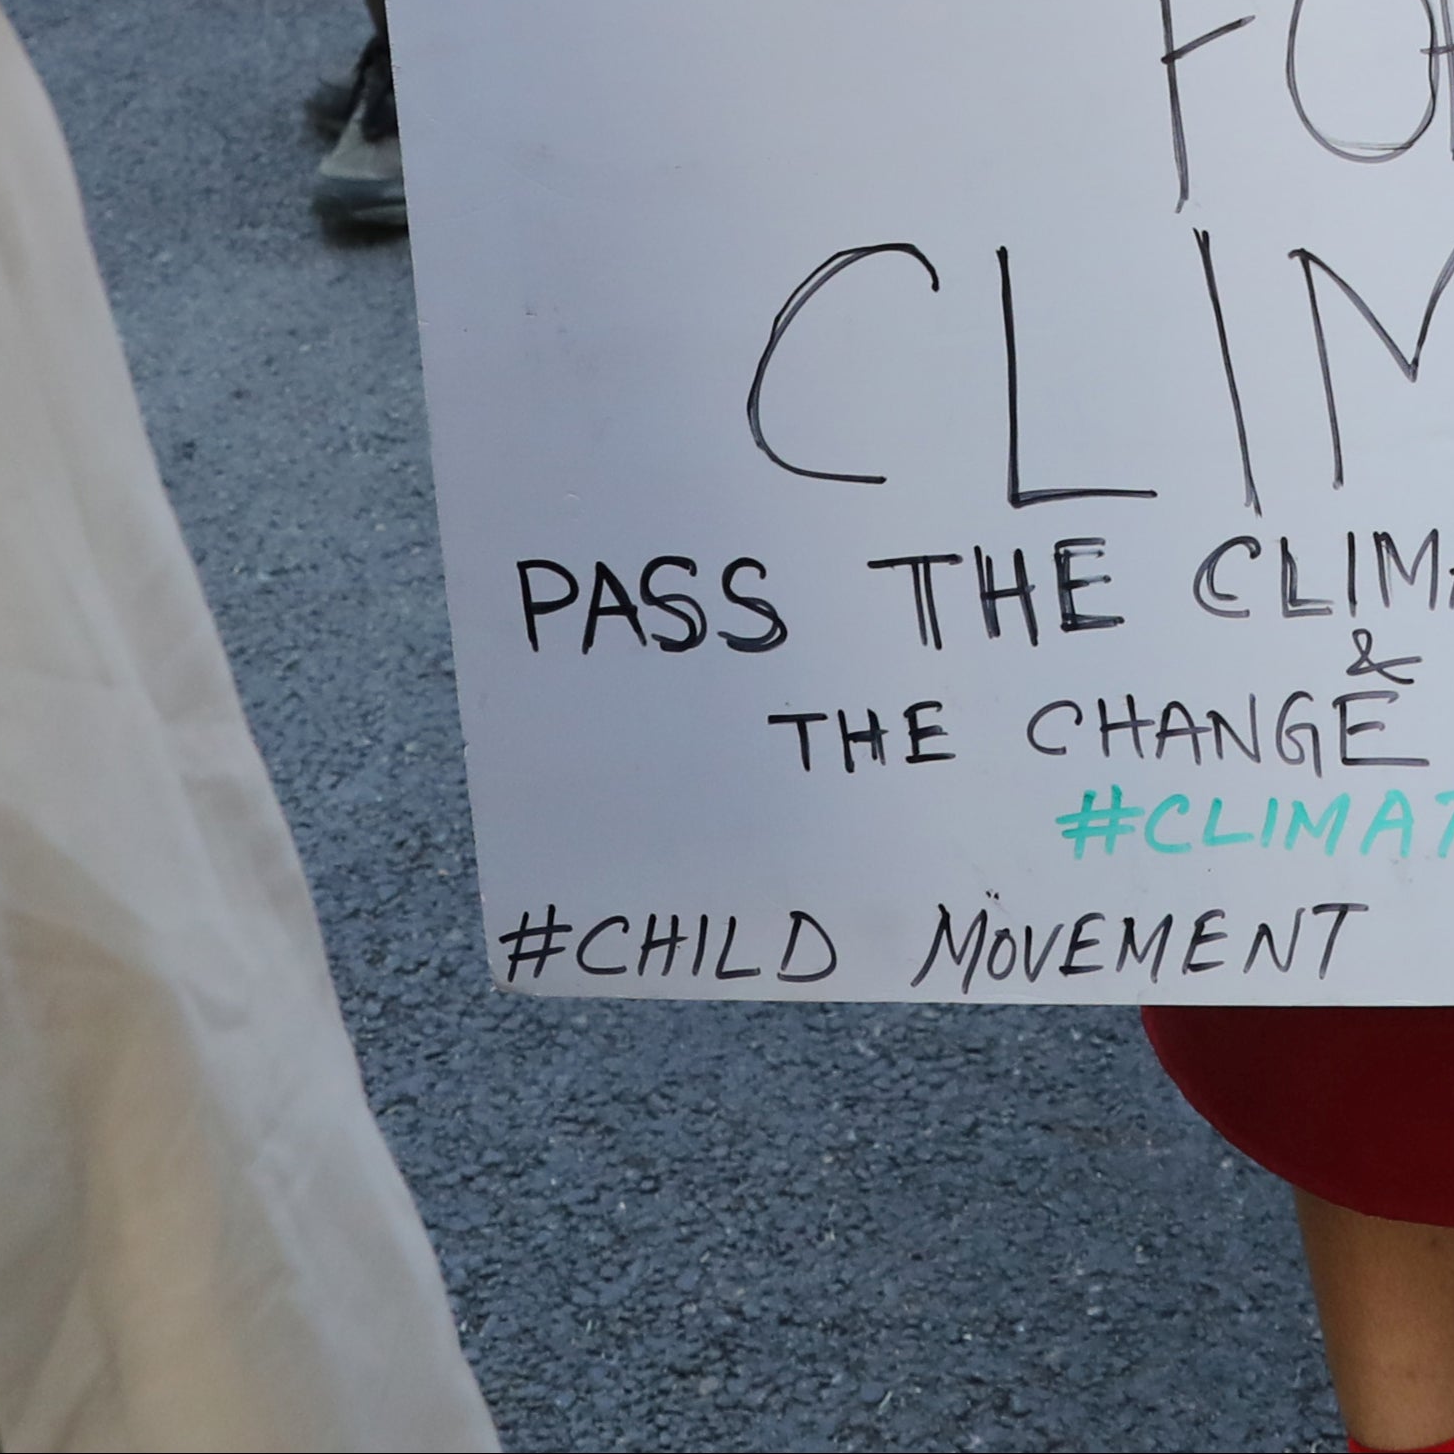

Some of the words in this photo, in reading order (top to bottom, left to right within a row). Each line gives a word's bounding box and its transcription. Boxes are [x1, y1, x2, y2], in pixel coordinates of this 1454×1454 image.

[516, 556, 789, 654] PASS
[868, 536, 1125, 649] THE
[1346, 628, 1423, 685] &
[767, 700, 957, 774] THE
[1026, 690, 1429, 778] CHANGE
[499, 903, 838, 984] #CHILD
[909, 899, 1370, 991] MOVEMENT
